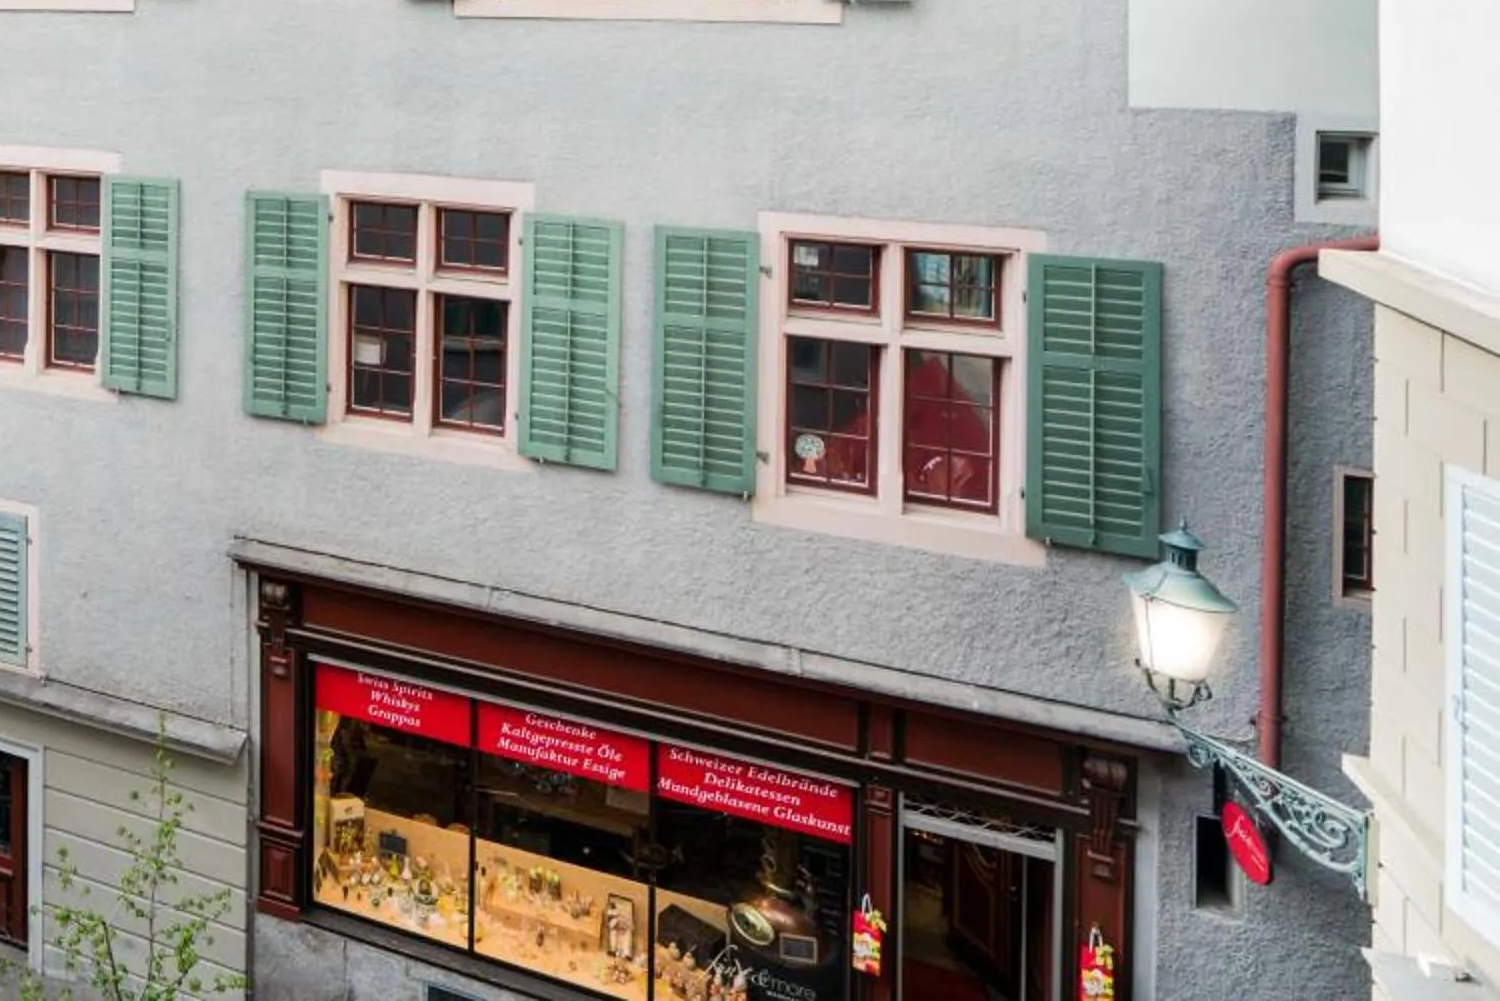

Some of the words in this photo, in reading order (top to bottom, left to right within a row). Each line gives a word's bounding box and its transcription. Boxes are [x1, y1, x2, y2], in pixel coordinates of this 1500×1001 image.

[371, 690, 421, 713] Whiskys
[393, 681, 434, 701] Spirits
[368, 704, 421, 727] Grappas
[525, 713, 597, 740] Geschenke
[497, 737, 579, 766] Manufaktur
[583, 759, 626, 780] Essige
[501, 722, 594, 756] Kaltgepresste
[597, 743, 623, 762] Öle
[669, 747, 744, 775] Schweizer
[748, 766, 839, 798] Edelbrände
[704, 772, 800, 806] Delikatessen
[657, 777, 770, 814] Mundgeblasene
[774, 806, 852, 836] Glaskunst
